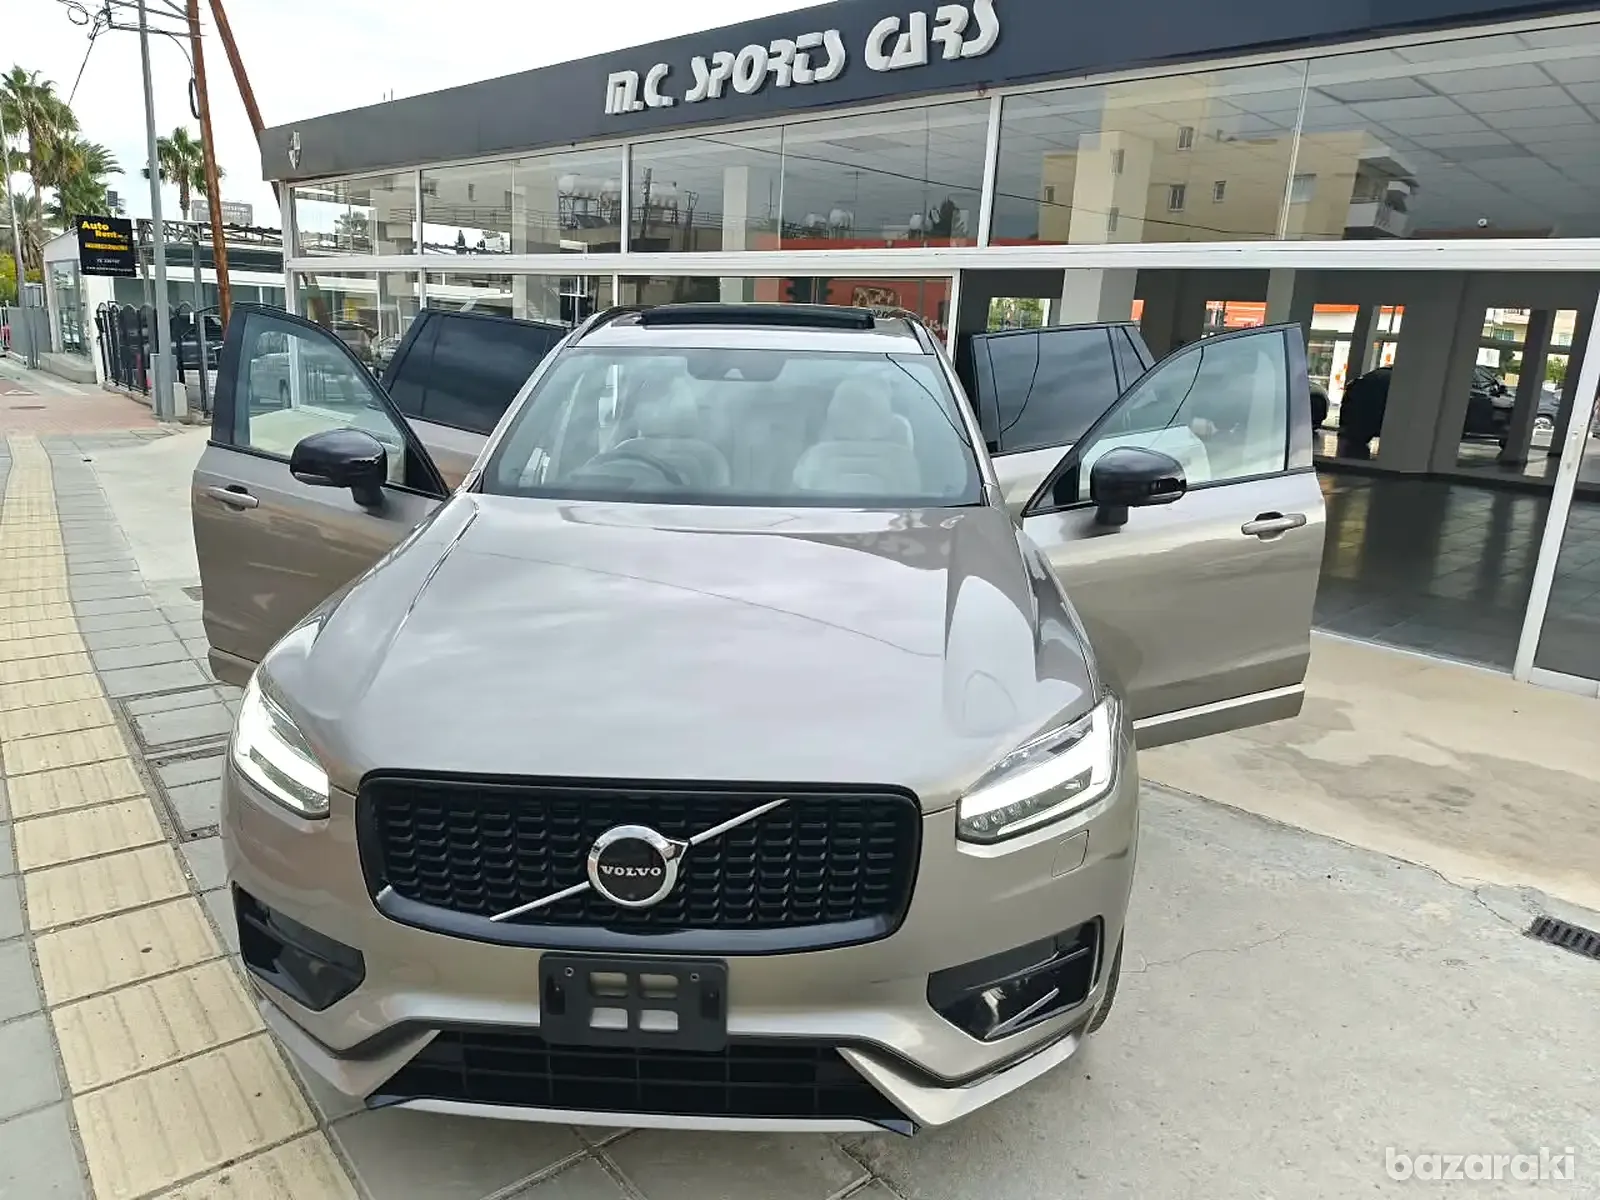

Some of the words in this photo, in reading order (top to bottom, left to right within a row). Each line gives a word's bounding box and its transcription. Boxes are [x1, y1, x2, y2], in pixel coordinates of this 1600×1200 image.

[685, 29, 846, 102] SPORTS
[865, 0, 999, 71] CARS
[81, 220, 109, 231] Auto
[600, 865, 661, 876] VOLVO
